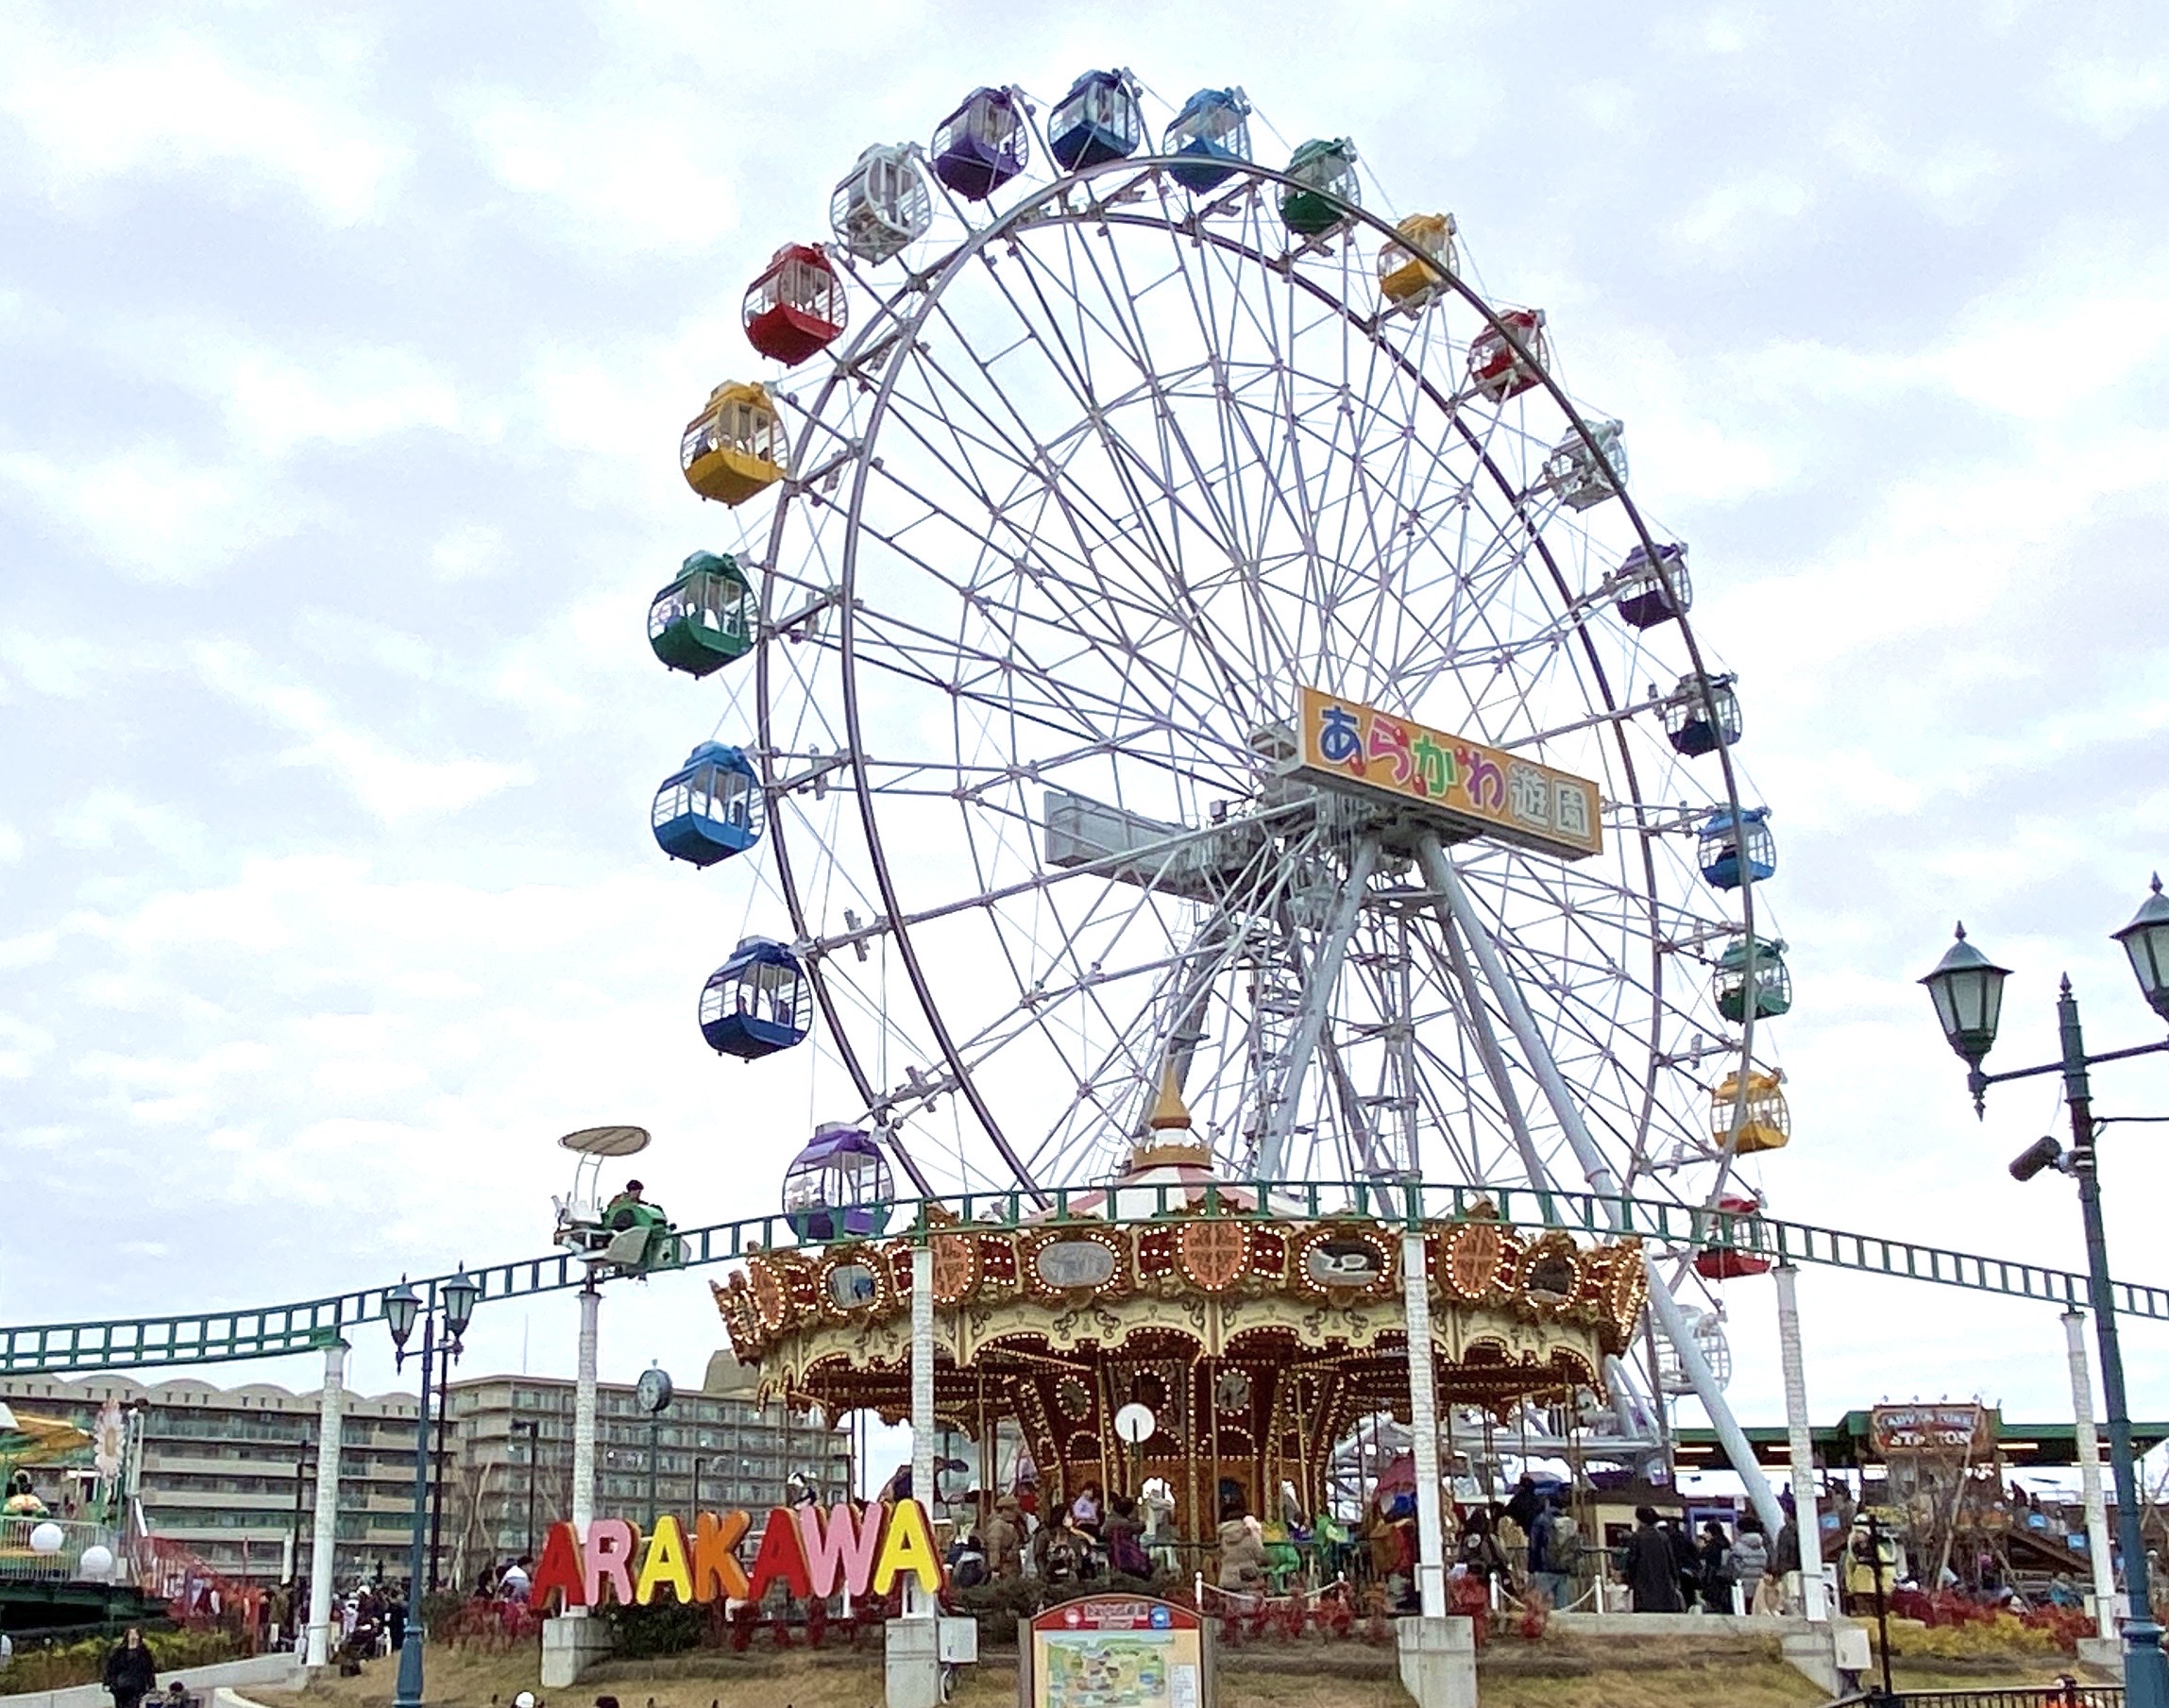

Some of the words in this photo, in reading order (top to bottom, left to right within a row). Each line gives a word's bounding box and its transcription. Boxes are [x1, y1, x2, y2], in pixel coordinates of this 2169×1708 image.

[1319, 704, 1592, 839] あらかわ遊園
[530, 1498, 942, 1609] ARAKAWA
